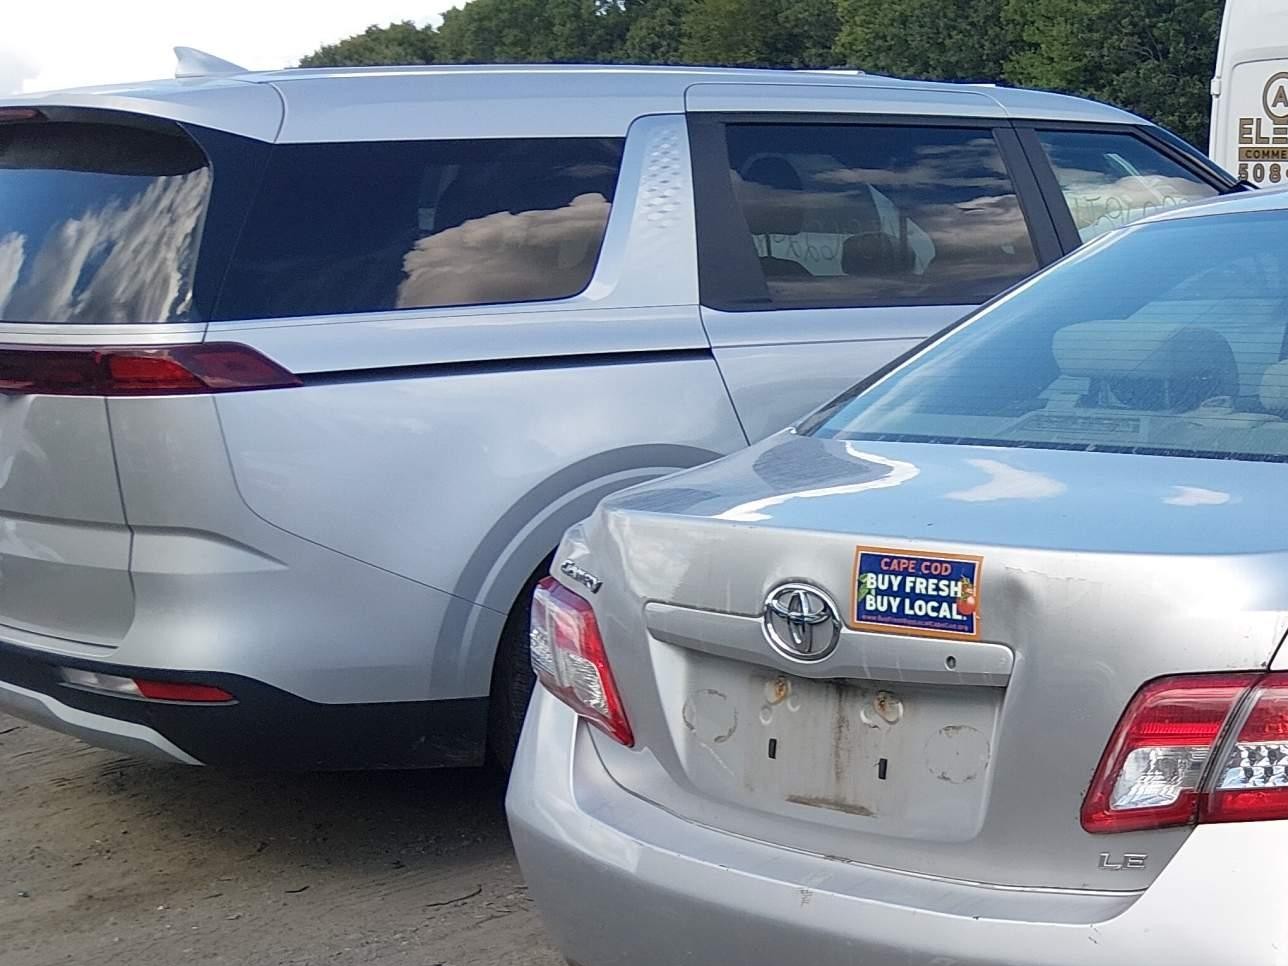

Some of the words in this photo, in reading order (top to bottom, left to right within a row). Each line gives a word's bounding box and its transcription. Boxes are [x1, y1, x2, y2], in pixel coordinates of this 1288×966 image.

[880, 558, 916, 573] CAPE
[921, 561, 952, 576] COD
[866, 573, 902, 592] BUY
[905, 577, 963, 598] FRESH
[865, 594, 901, 613] BUY
[1098, 851, 1149, 871] LE
